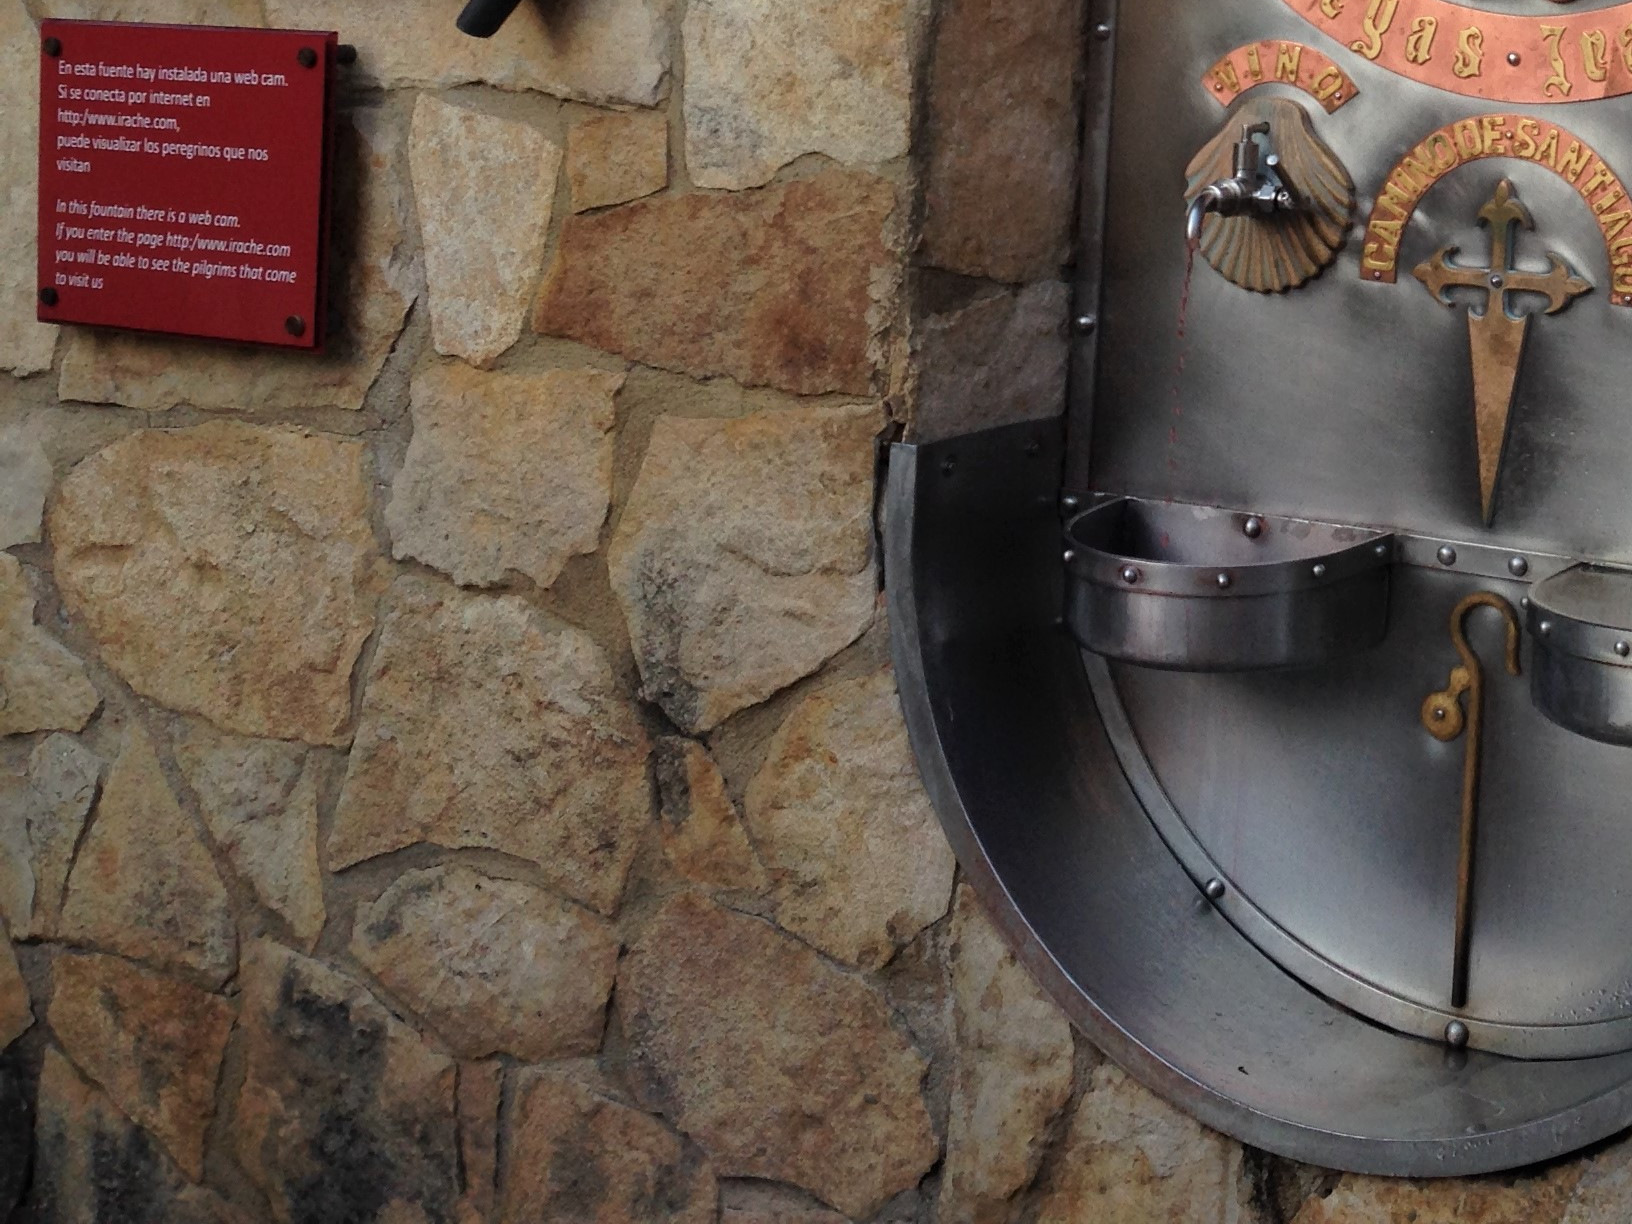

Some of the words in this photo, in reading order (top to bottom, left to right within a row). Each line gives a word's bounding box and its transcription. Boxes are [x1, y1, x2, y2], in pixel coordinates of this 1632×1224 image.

[59, 60, 72, 74] En
[74, 63, 96, 76] esta
[99, 62, 134, 78] fuente
[136, 63, 156, 82] hay
[158, 65, 207, 82] instalada
[210, 71, 231, 83] una
[234, 69, 258, 85] web
[261, 73, 288, 86] cam.
[1212, 44, 1342, 97] VINO
[58, 84, 67, 98] Si
[70, 88, 82, 99] se
[84, 89, 125, 102] conecta
[128, 91, 147, 106] por
[149, 89, 193, 106] internet
[196, 95, 211, 107] en
[57, 133, 90, 150] puede
[92, 135, 141, 152] visualizar
[144, 137, 159, 153] los
[162, 142, 221, 159] peregrinos
[223, 146, 245, 162] que
[248, 148, 268, 161] nos
[57, 157, 91, 172] visitan
[1364, 132, 1459, 270] CAMINO
[1453, 117, 1505, 158] DE
[56, 199, 66, 213] In
[69, 199, 87, 214] this
[88, 201, 134, 219] fountain
[136, 205, 165, 221] there
[167, 207, 176, 223] is
[178, 212, 186, 224] a
[188, 210, 212, 225] web
[214, 215, 241, 227] cam.
[56, 222, 65, 240] If
[65, 226, 85, 240] you
[87, 227, 115, 241] enter
[117, 228, 135, 243] the
[136, 233, 164, 248] page
[55, 249, 75, 263] you
[77, 248, 96, 264] will
[97, 250, 111, 265] be
[112, 252, 135, 267] able
[138, 257, 149, 269] to
[151, 259, 170, 271] see
[172, 258, 190, 273] the
[192, 259, 237, 279] pilgrims
[239, 264, 263, 280] that
[265, 269, 297, 284] come
[55, 272, 66, 285] to
[69, 272, 89, 288] visit
[91, 278, 103, 289] us
